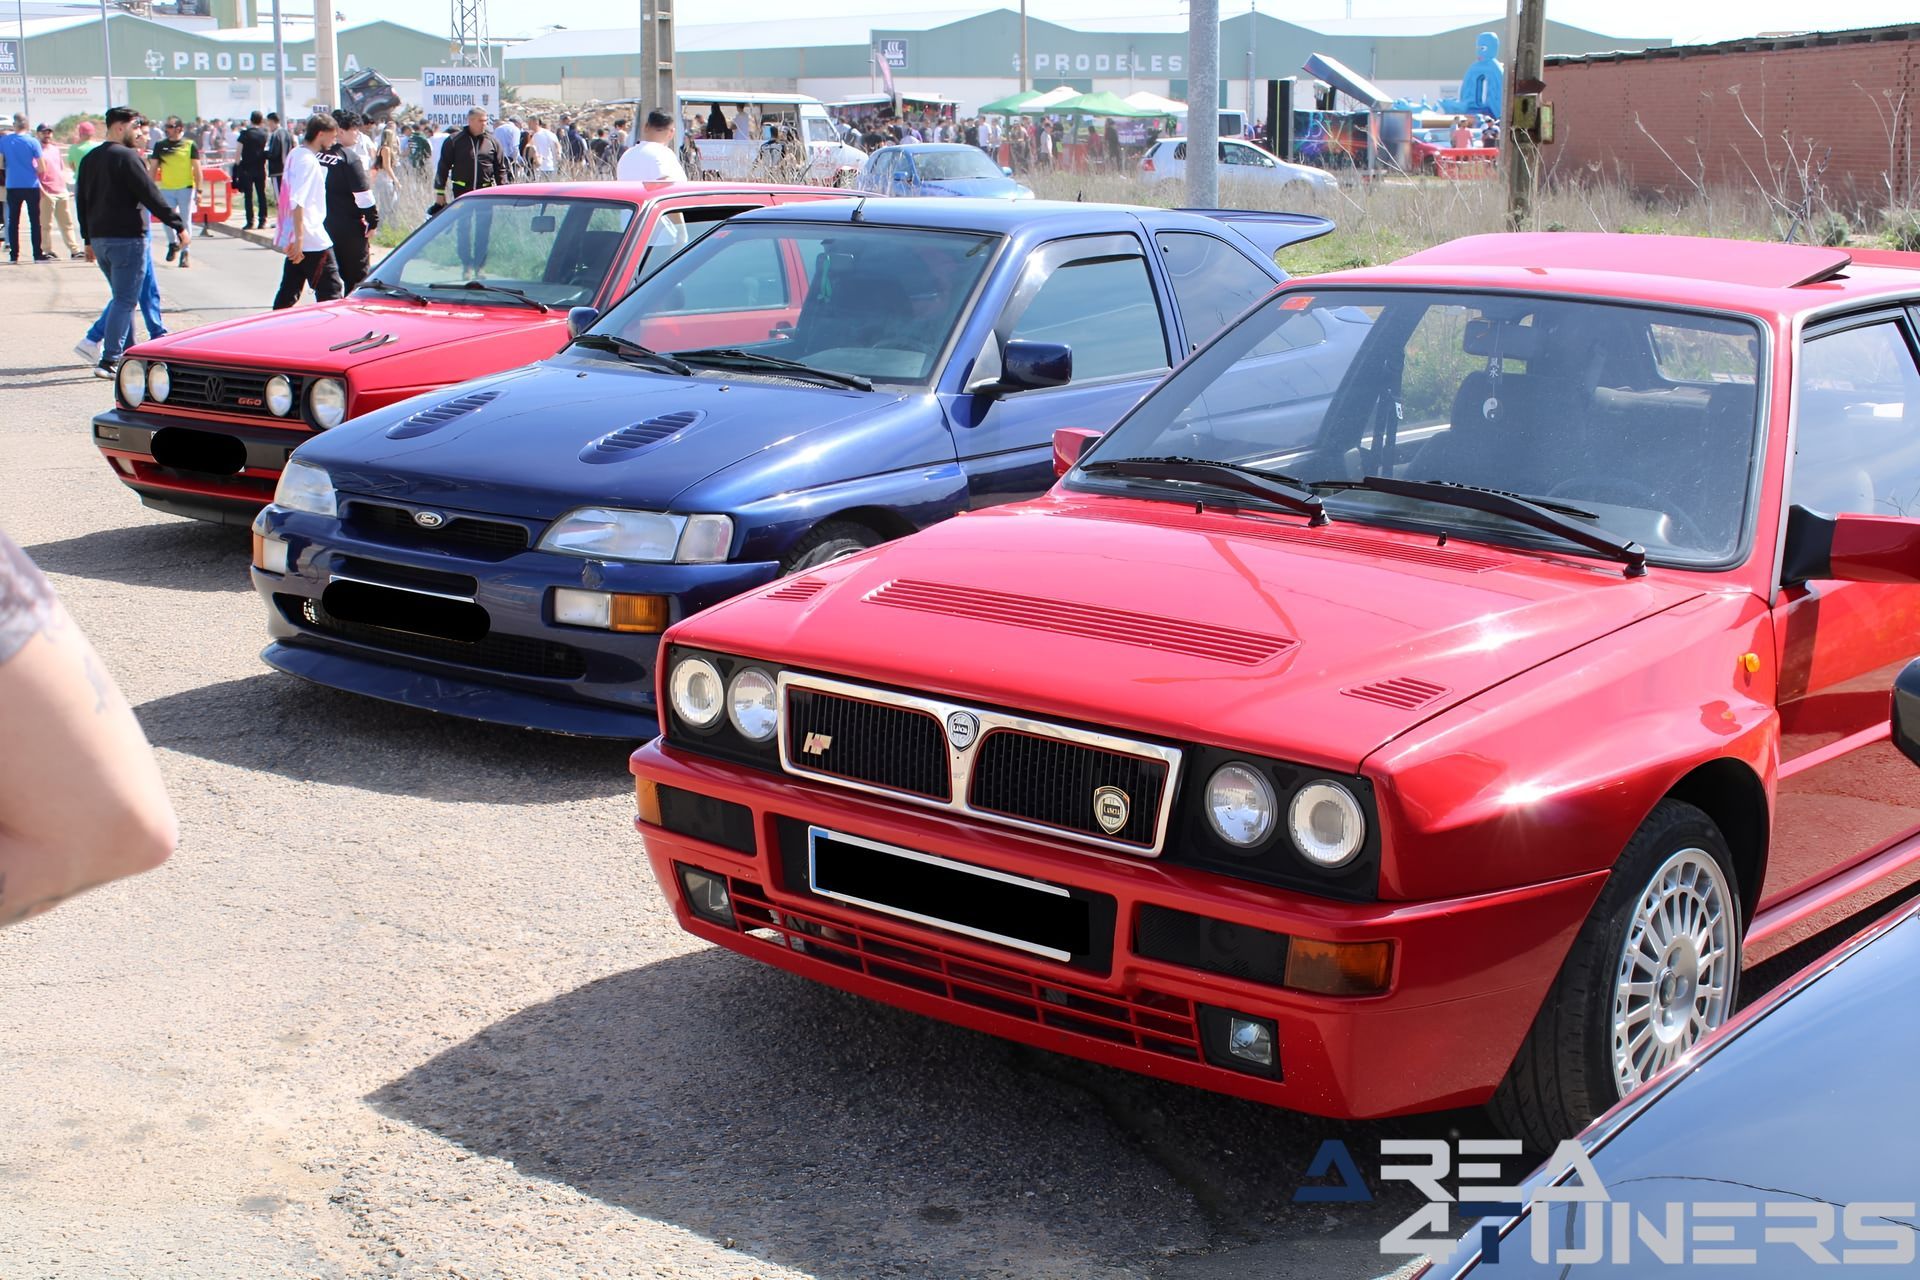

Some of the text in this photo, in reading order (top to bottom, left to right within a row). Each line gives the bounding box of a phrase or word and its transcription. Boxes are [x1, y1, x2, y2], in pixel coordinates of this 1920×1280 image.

[173, 51, 361, 72] PRODELEA
[436, 74, 496, 87] APARCAMIENTO
[433, 94, 476, 106] MUNICIPAL
[427, 113, 450, 126] PARA
